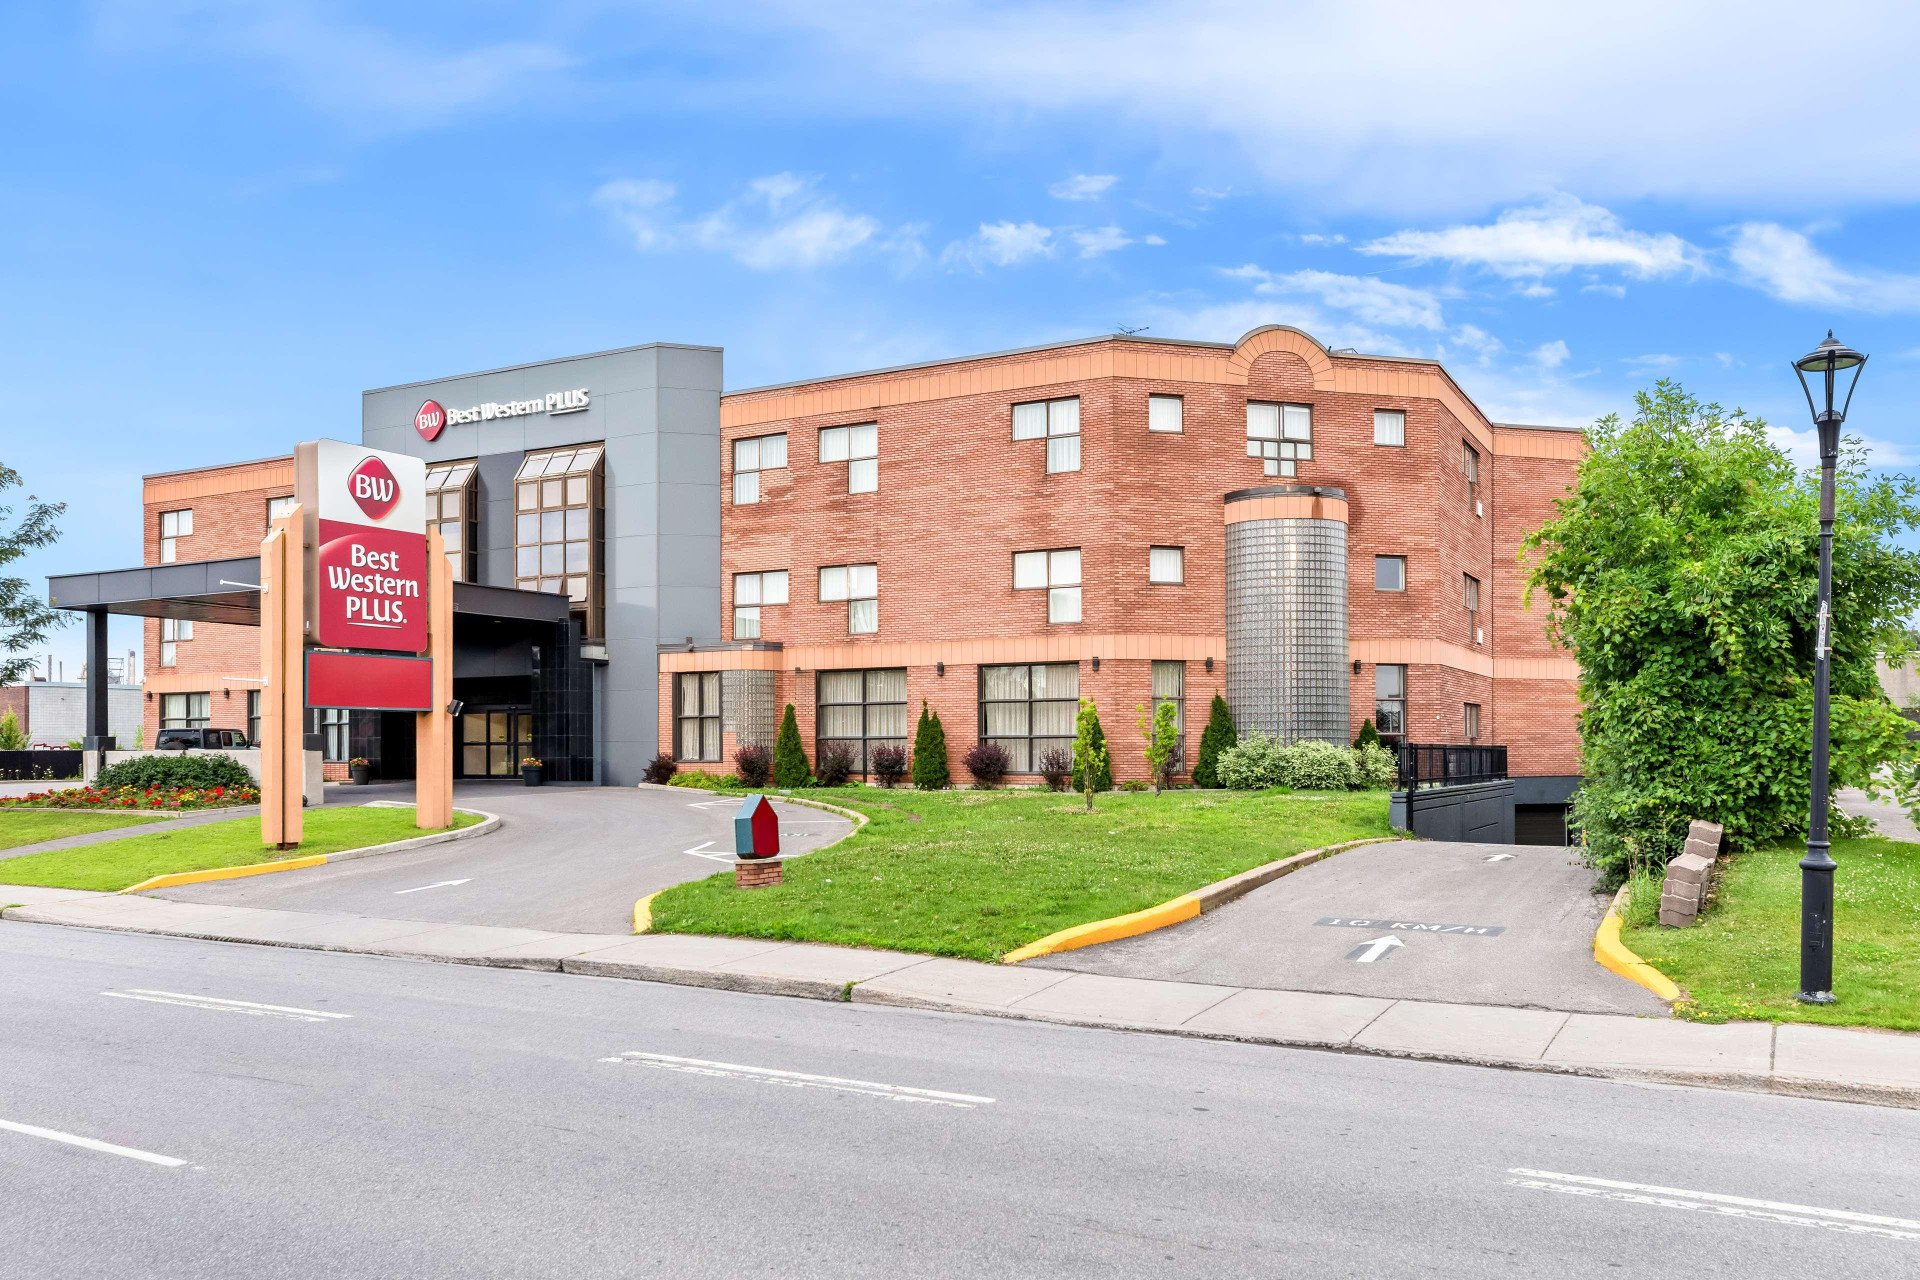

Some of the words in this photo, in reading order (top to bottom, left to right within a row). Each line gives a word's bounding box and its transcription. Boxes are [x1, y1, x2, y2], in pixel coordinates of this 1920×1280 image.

[447, 406, 480, 425] Best
[481, 399, 544, 419] Western
[546, 388, 589, 411] PLUS
[419, 412, 440, 430] BW
[355, 473, 394, 502] BW
[351, 544, 400, 572] Best
[328, 566, 419, 597] Western
[1329, 918, 1371, 926] 10
[1390, 922, 1488, 934] KM/H
